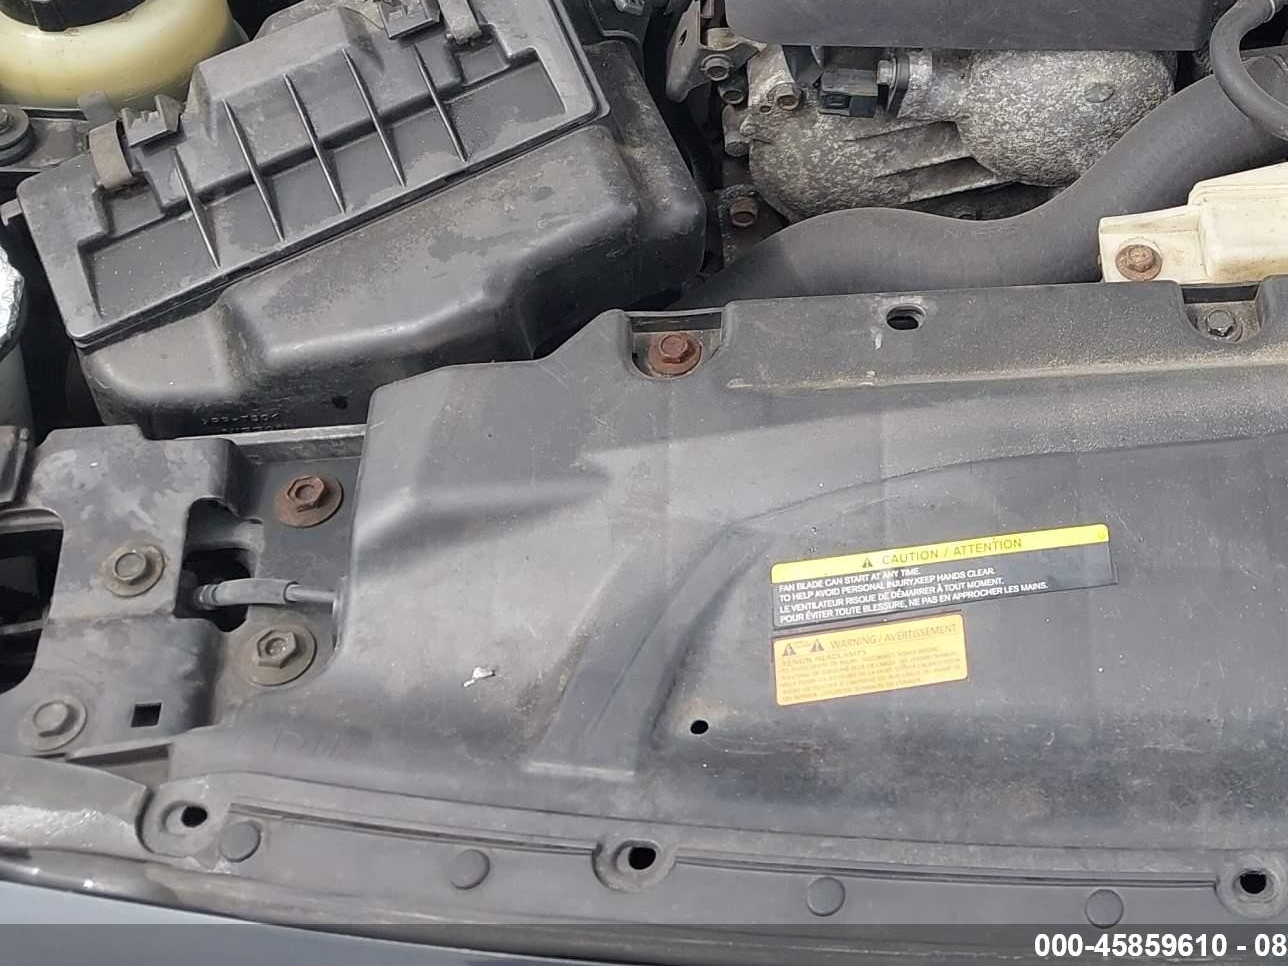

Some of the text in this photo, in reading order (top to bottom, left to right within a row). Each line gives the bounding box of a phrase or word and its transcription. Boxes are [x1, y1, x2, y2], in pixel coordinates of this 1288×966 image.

[882, 537, 1022, 565] CAUTION / ATTENTION
[779, 567, 921, 593] FAN BLADE CAN START AT ANY TIME.
[780, 594, 790, 603] TO
[792, 590, 814, 601] HELP
[815, 587, 840, 598] AVOID
[842, 582, 883, 594] PERSONAL
[937, 570, 966, 582] HANDS
[967, 567, 996, 578] CLEAR.
[780, 604, 790, 614] LE
[791, 597, 844, 612] VENTILATEUR
[846, 593, 877, 606] RISQUE
[878, 591, 889, 601] DE
[891, 585, 939, 600] DÉMARRER
[945, 581, 965, 592] TOUT
[967, 577, 1004, 589] MOMENT.
[780, 581, 1048, 624] POUR ÉVITER TOUTE BLESSURE, NE PAS EN APPROCHER LES MAINS.
[830, 634, 876, 650] WARNING
[885, 623, 957, 643] AVERTISSEMENT
